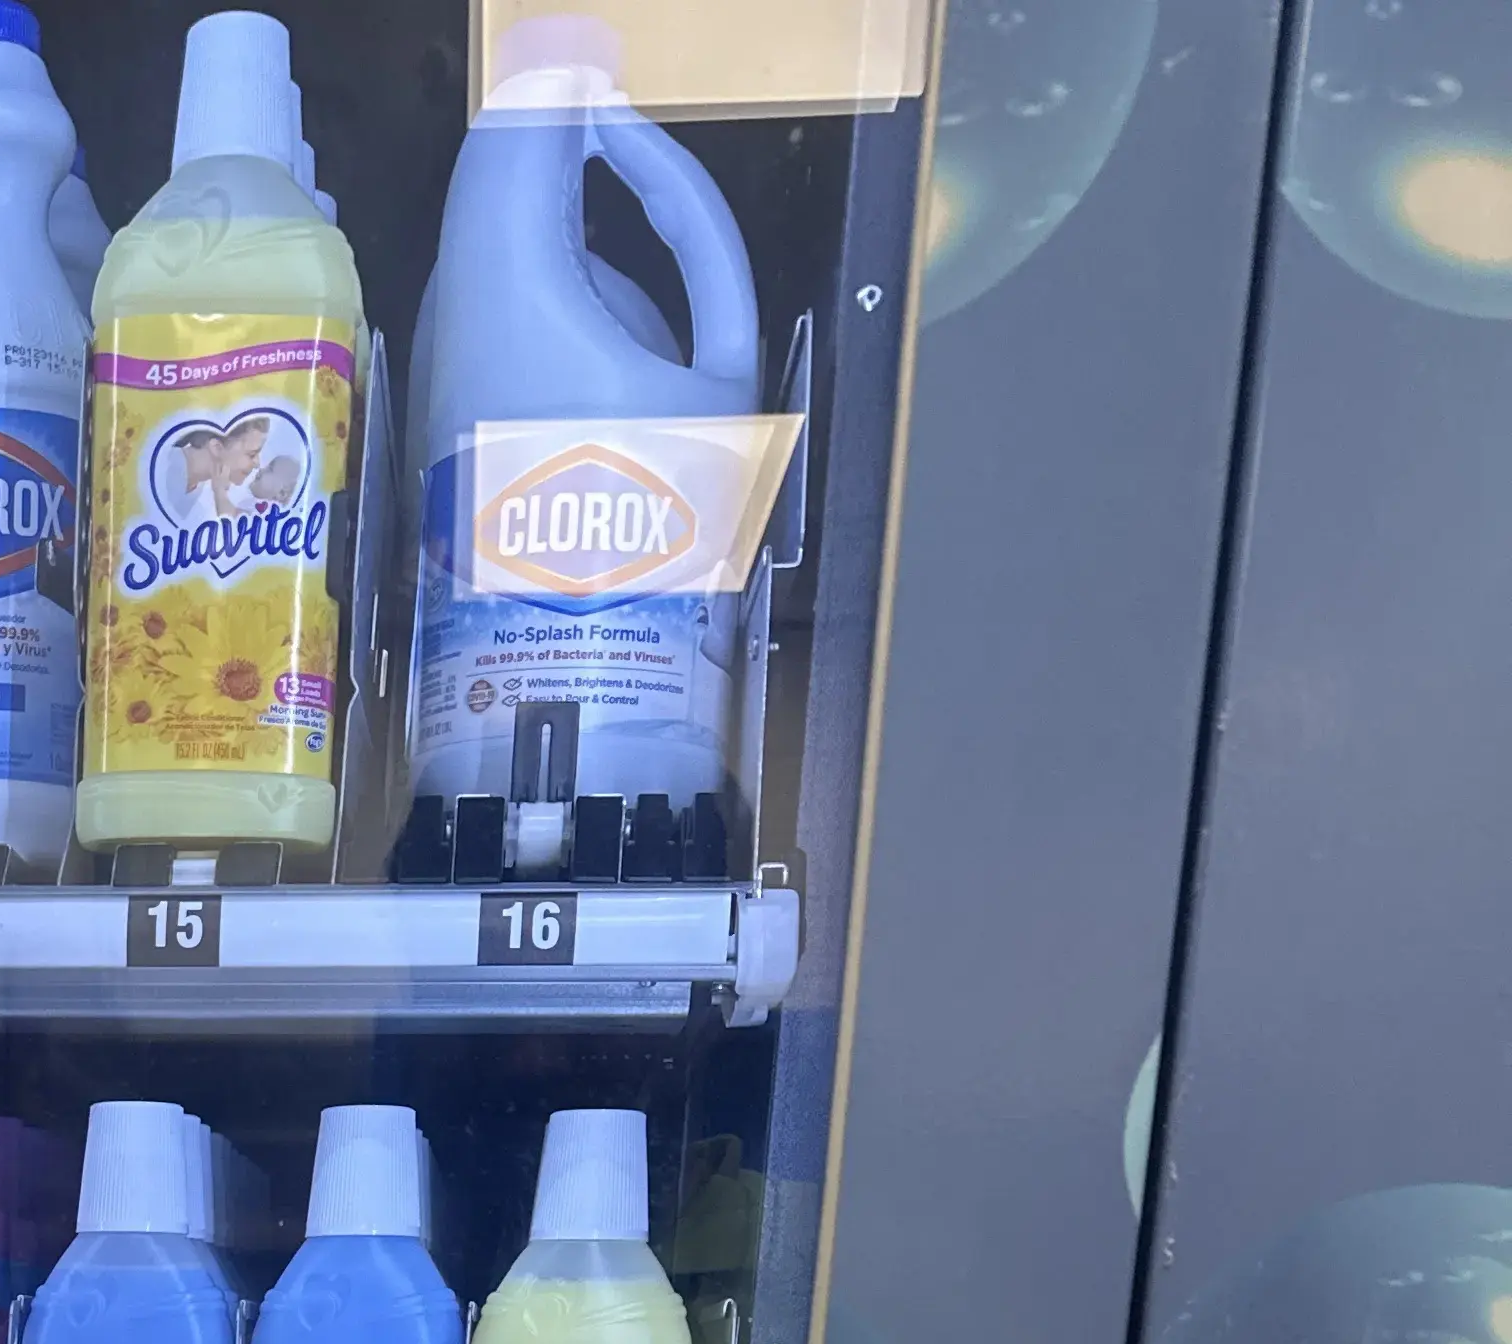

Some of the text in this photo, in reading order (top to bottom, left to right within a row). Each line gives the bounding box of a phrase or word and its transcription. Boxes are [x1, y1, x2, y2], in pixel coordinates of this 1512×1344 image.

[145, 348, 322, 386] 45 Days of Freshness
[498, 492, 673, 557] CLOROX
[123, 501, 326, 590] Suavitel
[0, 626, 41, 642] 99.9%
[494, 625, 660, 646] No-Splash Formula
[3, 643, 12, 657] y
[475, 650, 631, 667] Kills 99.9% of and
[278, 676, 301, 696] 13
[575, 678, 624, 691] Brightens
[602, 694, 639, 706] Control
[147, 901, 204, 949] 15
[502, 901, 560, 950] 16
